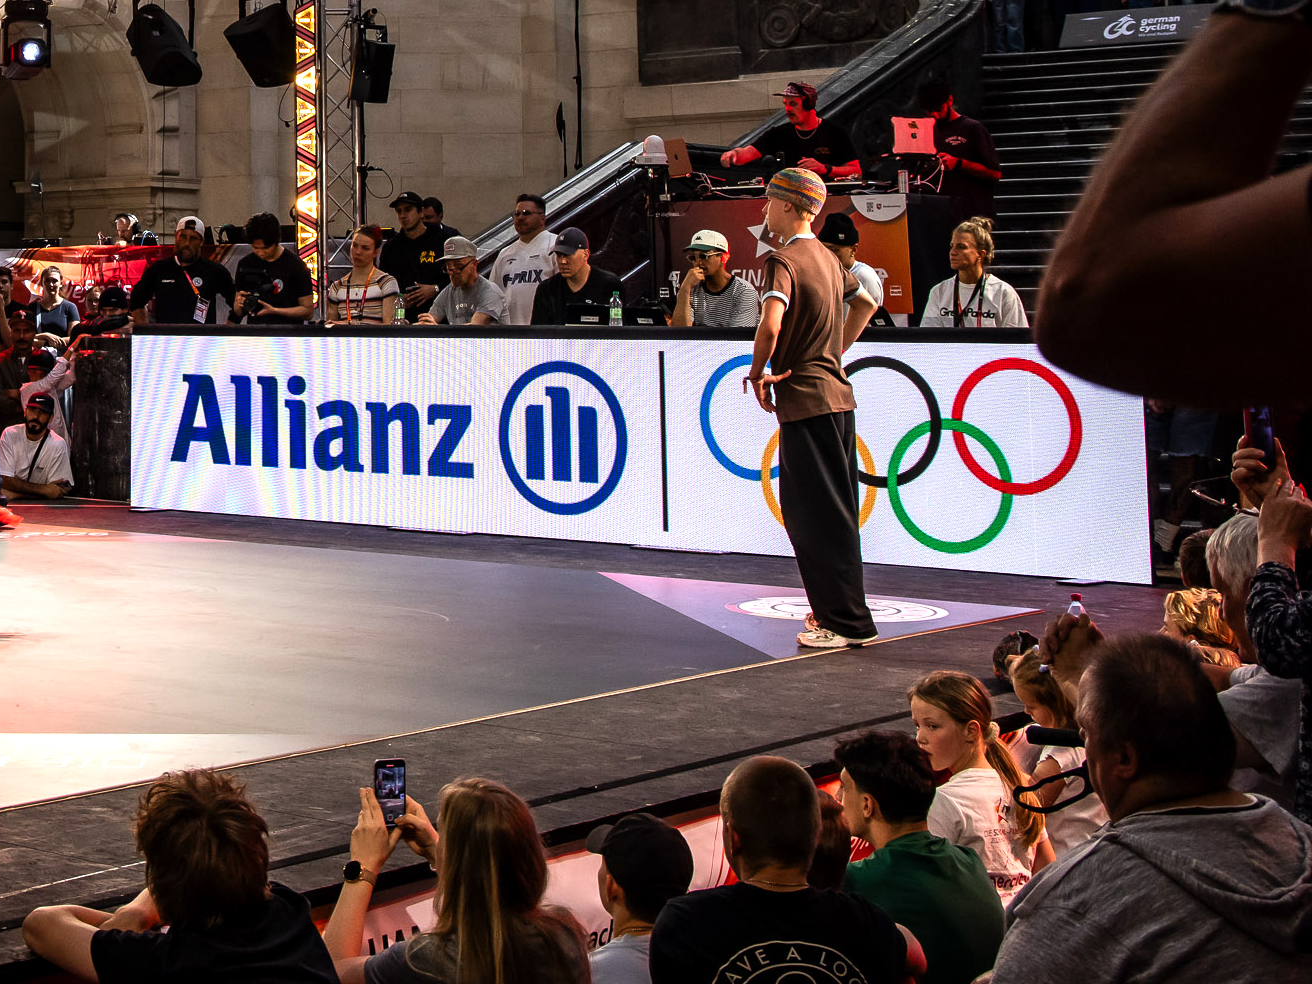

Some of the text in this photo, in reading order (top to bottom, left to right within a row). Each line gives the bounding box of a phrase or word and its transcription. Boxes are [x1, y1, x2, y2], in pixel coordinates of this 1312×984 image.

[1141, 15, 1181, 26] german
[1139, 22, 1177, 33] cycling
[939, 307, 996, 319] GrePada
[170, 372, 475, 480] Allianz
[990, 872, 1030, 889] nercity
[787, 946, 802, 961] A
